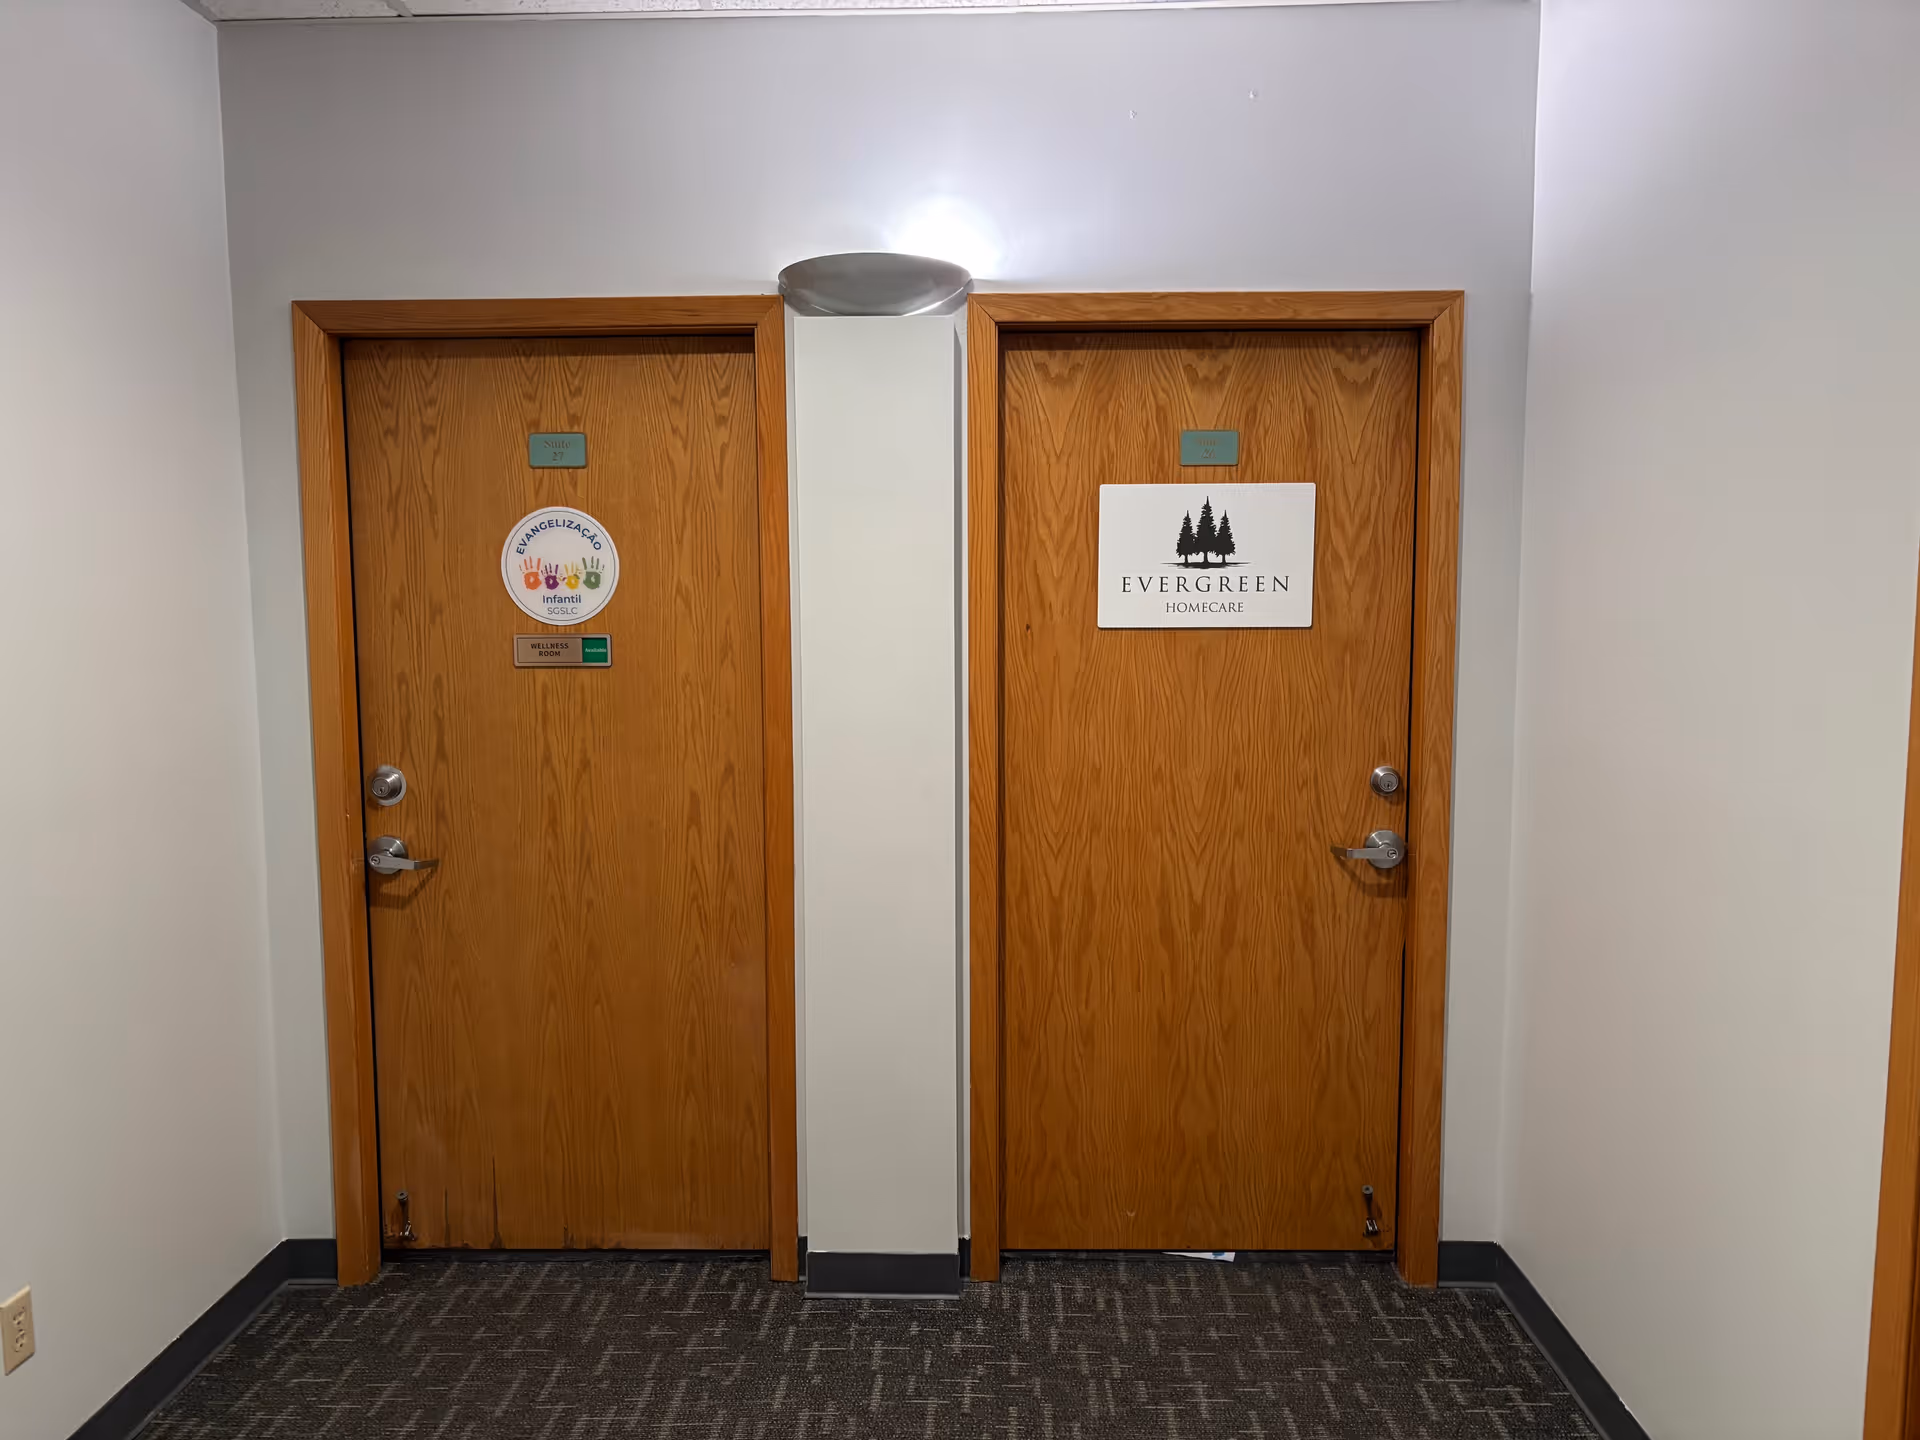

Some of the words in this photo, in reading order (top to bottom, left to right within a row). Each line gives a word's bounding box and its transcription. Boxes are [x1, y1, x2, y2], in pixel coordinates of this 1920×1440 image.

[516, 518, 602, 555] EVANGELIZAÇÃO
[1121, 575, 1290, 593] EVERGREEN
[542, 594, 581, 604] Infantil
[547, 606, 578, 615] SGSLC
[1165, 602, 1244, 613] HOMECARE
[530, 642, 569, 650] WELLNESS
